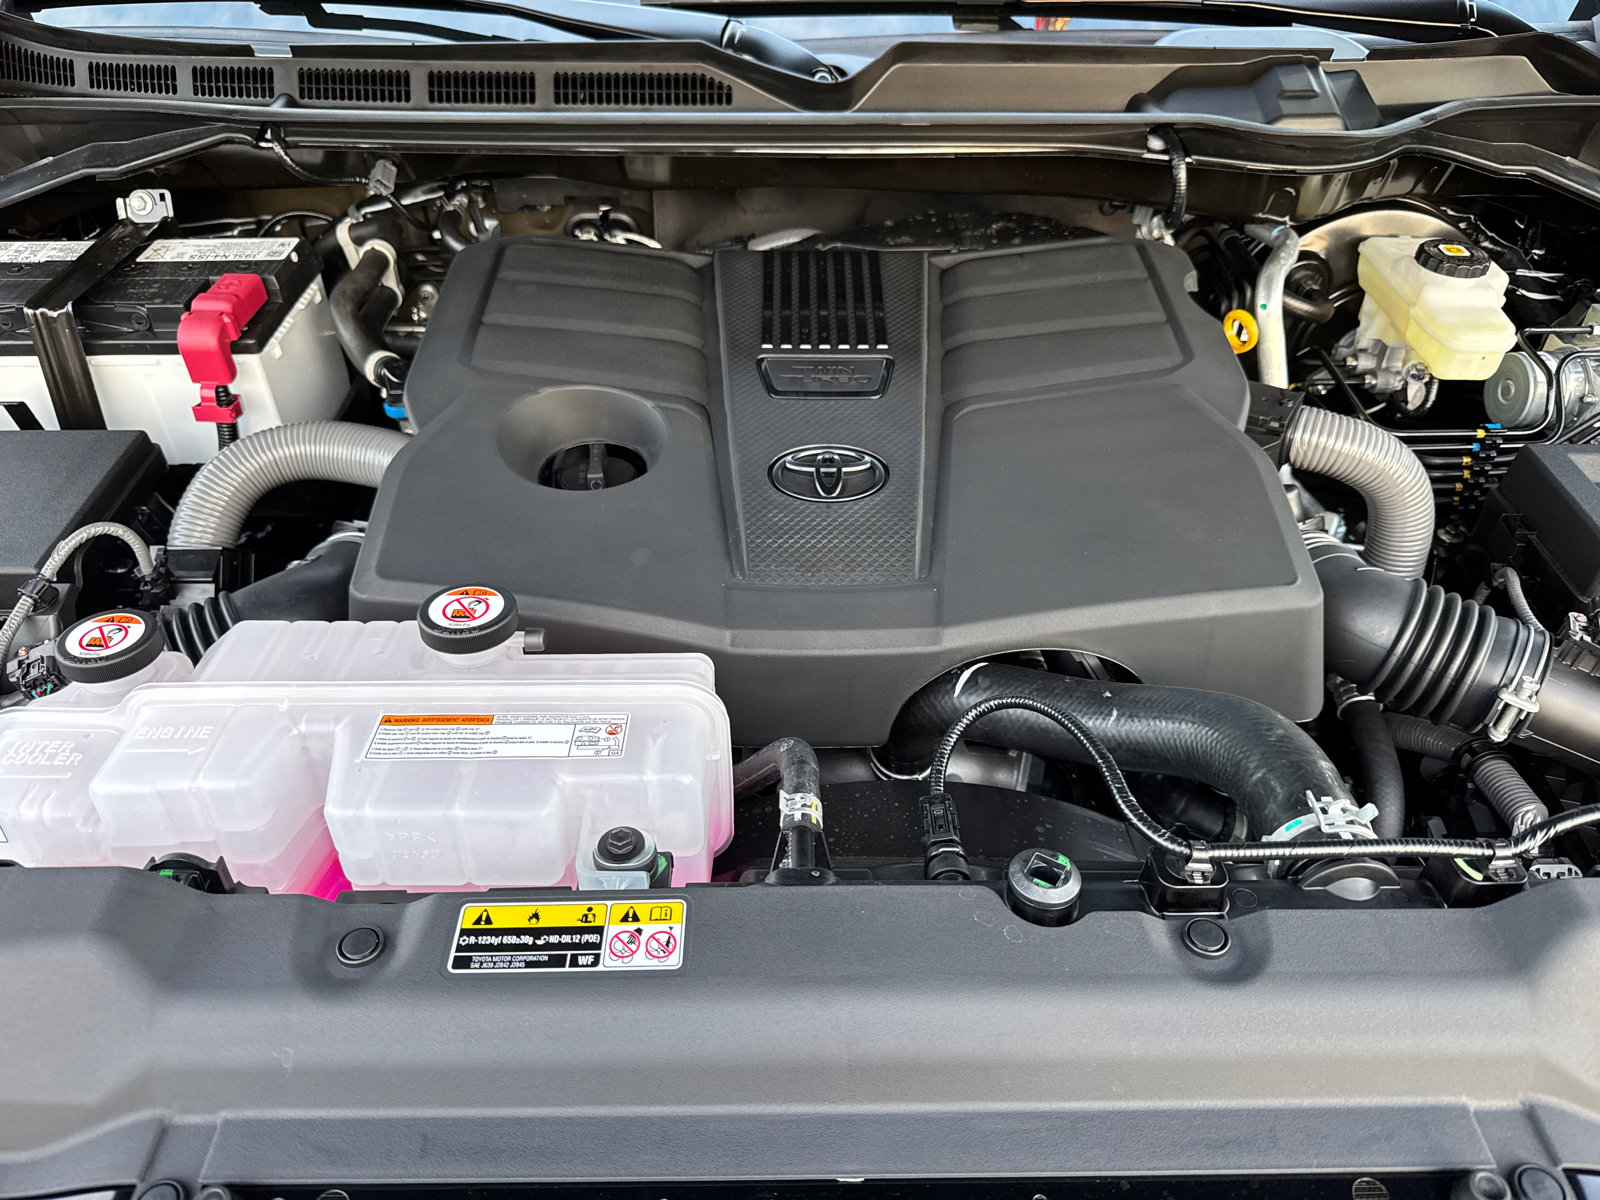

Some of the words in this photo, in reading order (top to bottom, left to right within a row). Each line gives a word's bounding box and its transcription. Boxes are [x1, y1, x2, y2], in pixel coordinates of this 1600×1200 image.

[791, 365, 855, 377] TWIN
[779, 374, 873, 384] TURBO
[135, 725, 214, 740] ENGINE
[8, 740, 76, 752] INTER
[1, 752, 84, 766] COOLER
[468, 935, 502, 946] R-1234yf
[502, 935, 534, 945] 650±30g
[548, 934, 581, 944] ND-OIL12
[581, 934, 600, 944] (POE)
[577, 955, 595, 966] WF
